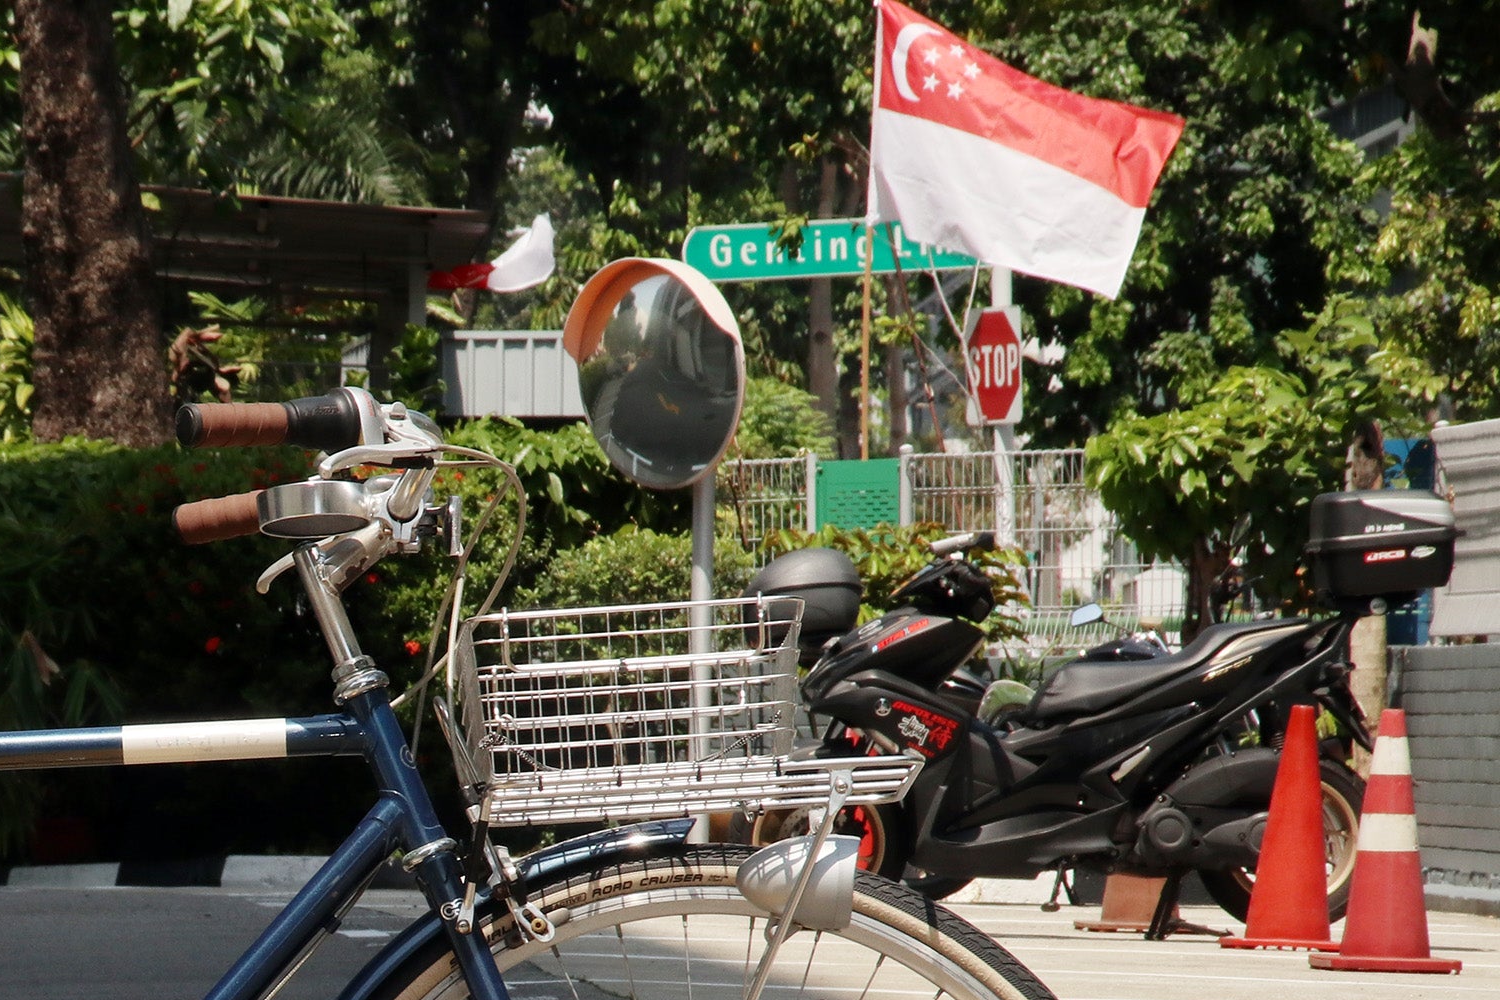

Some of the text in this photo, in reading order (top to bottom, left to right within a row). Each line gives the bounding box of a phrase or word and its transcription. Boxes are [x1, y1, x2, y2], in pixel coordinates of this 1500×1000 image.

[969, 342, 1019, 389] STOP
[592, 880, 633, 898] ROAD
[639, 873, 704, 887] CRUISER
